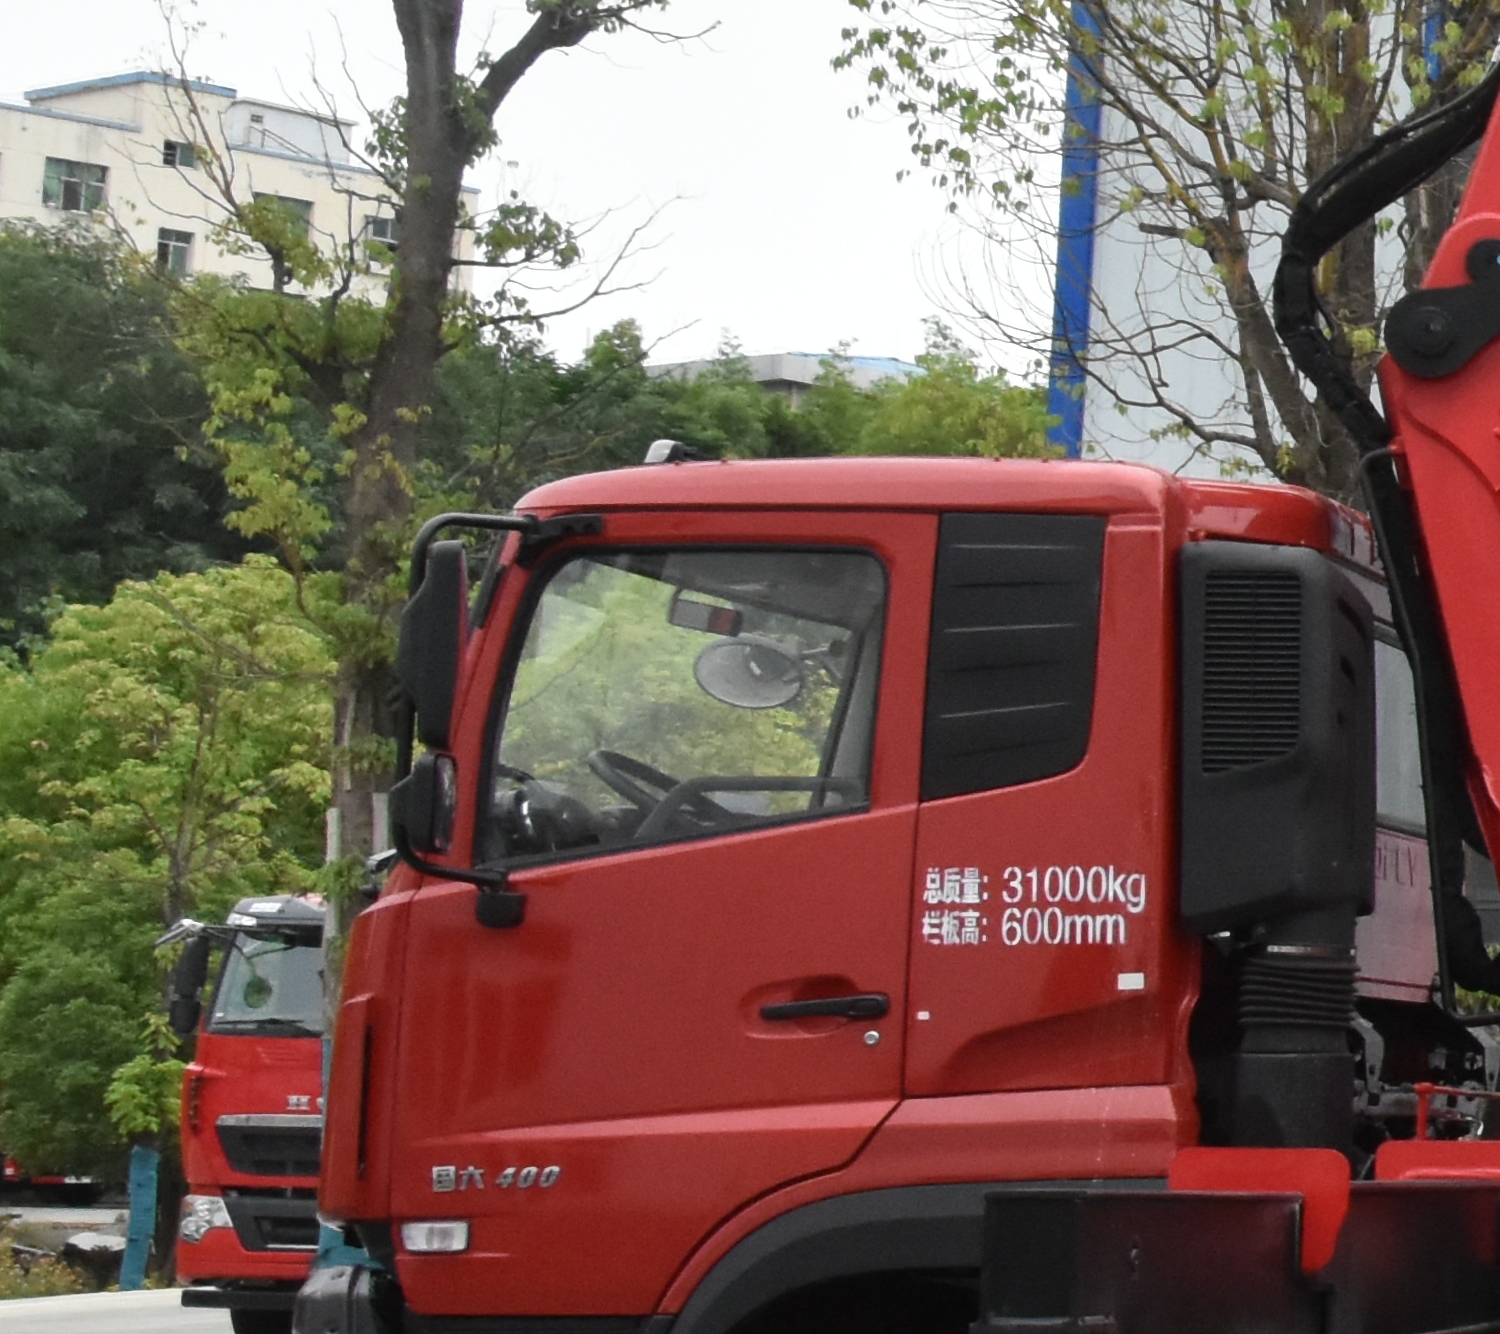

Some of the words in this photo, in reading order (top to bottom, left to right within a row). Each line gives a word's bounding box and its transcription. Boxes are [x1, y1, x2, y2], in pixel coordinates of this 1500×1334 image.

[1002, 865, 1146, 914] 31000kg
[1002, 907, 1127, 946] 600mm
[432, 1165, 484, 1192] 国六
[495, 1165, 561, 1188] 400
